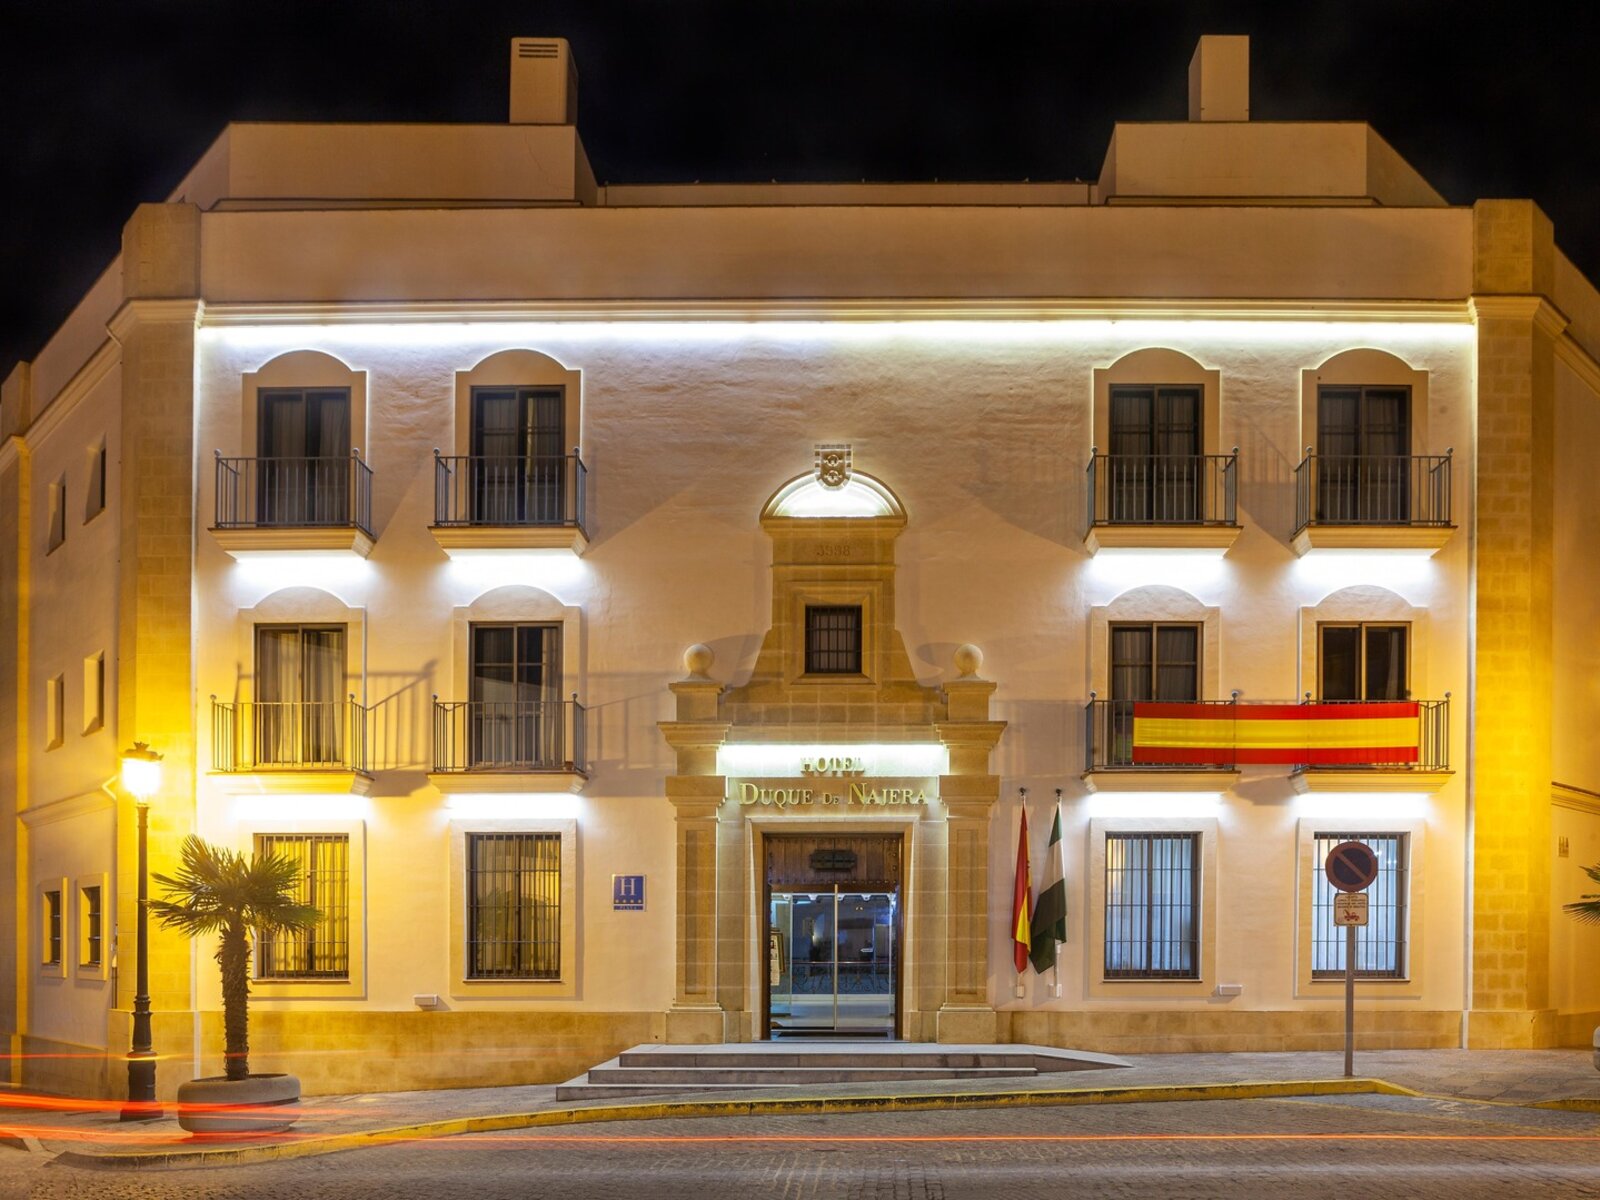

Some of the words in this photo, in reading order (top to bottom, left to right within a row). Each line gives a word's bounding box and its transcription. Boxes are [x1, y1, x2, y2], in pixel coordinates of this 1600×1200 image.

[800, 757, 864, 772] HOTEL
[739, 783, 814, 809] DUQUE
[848, 783, 928, 806] NAJERA
[620, 878, 636, 896] H
